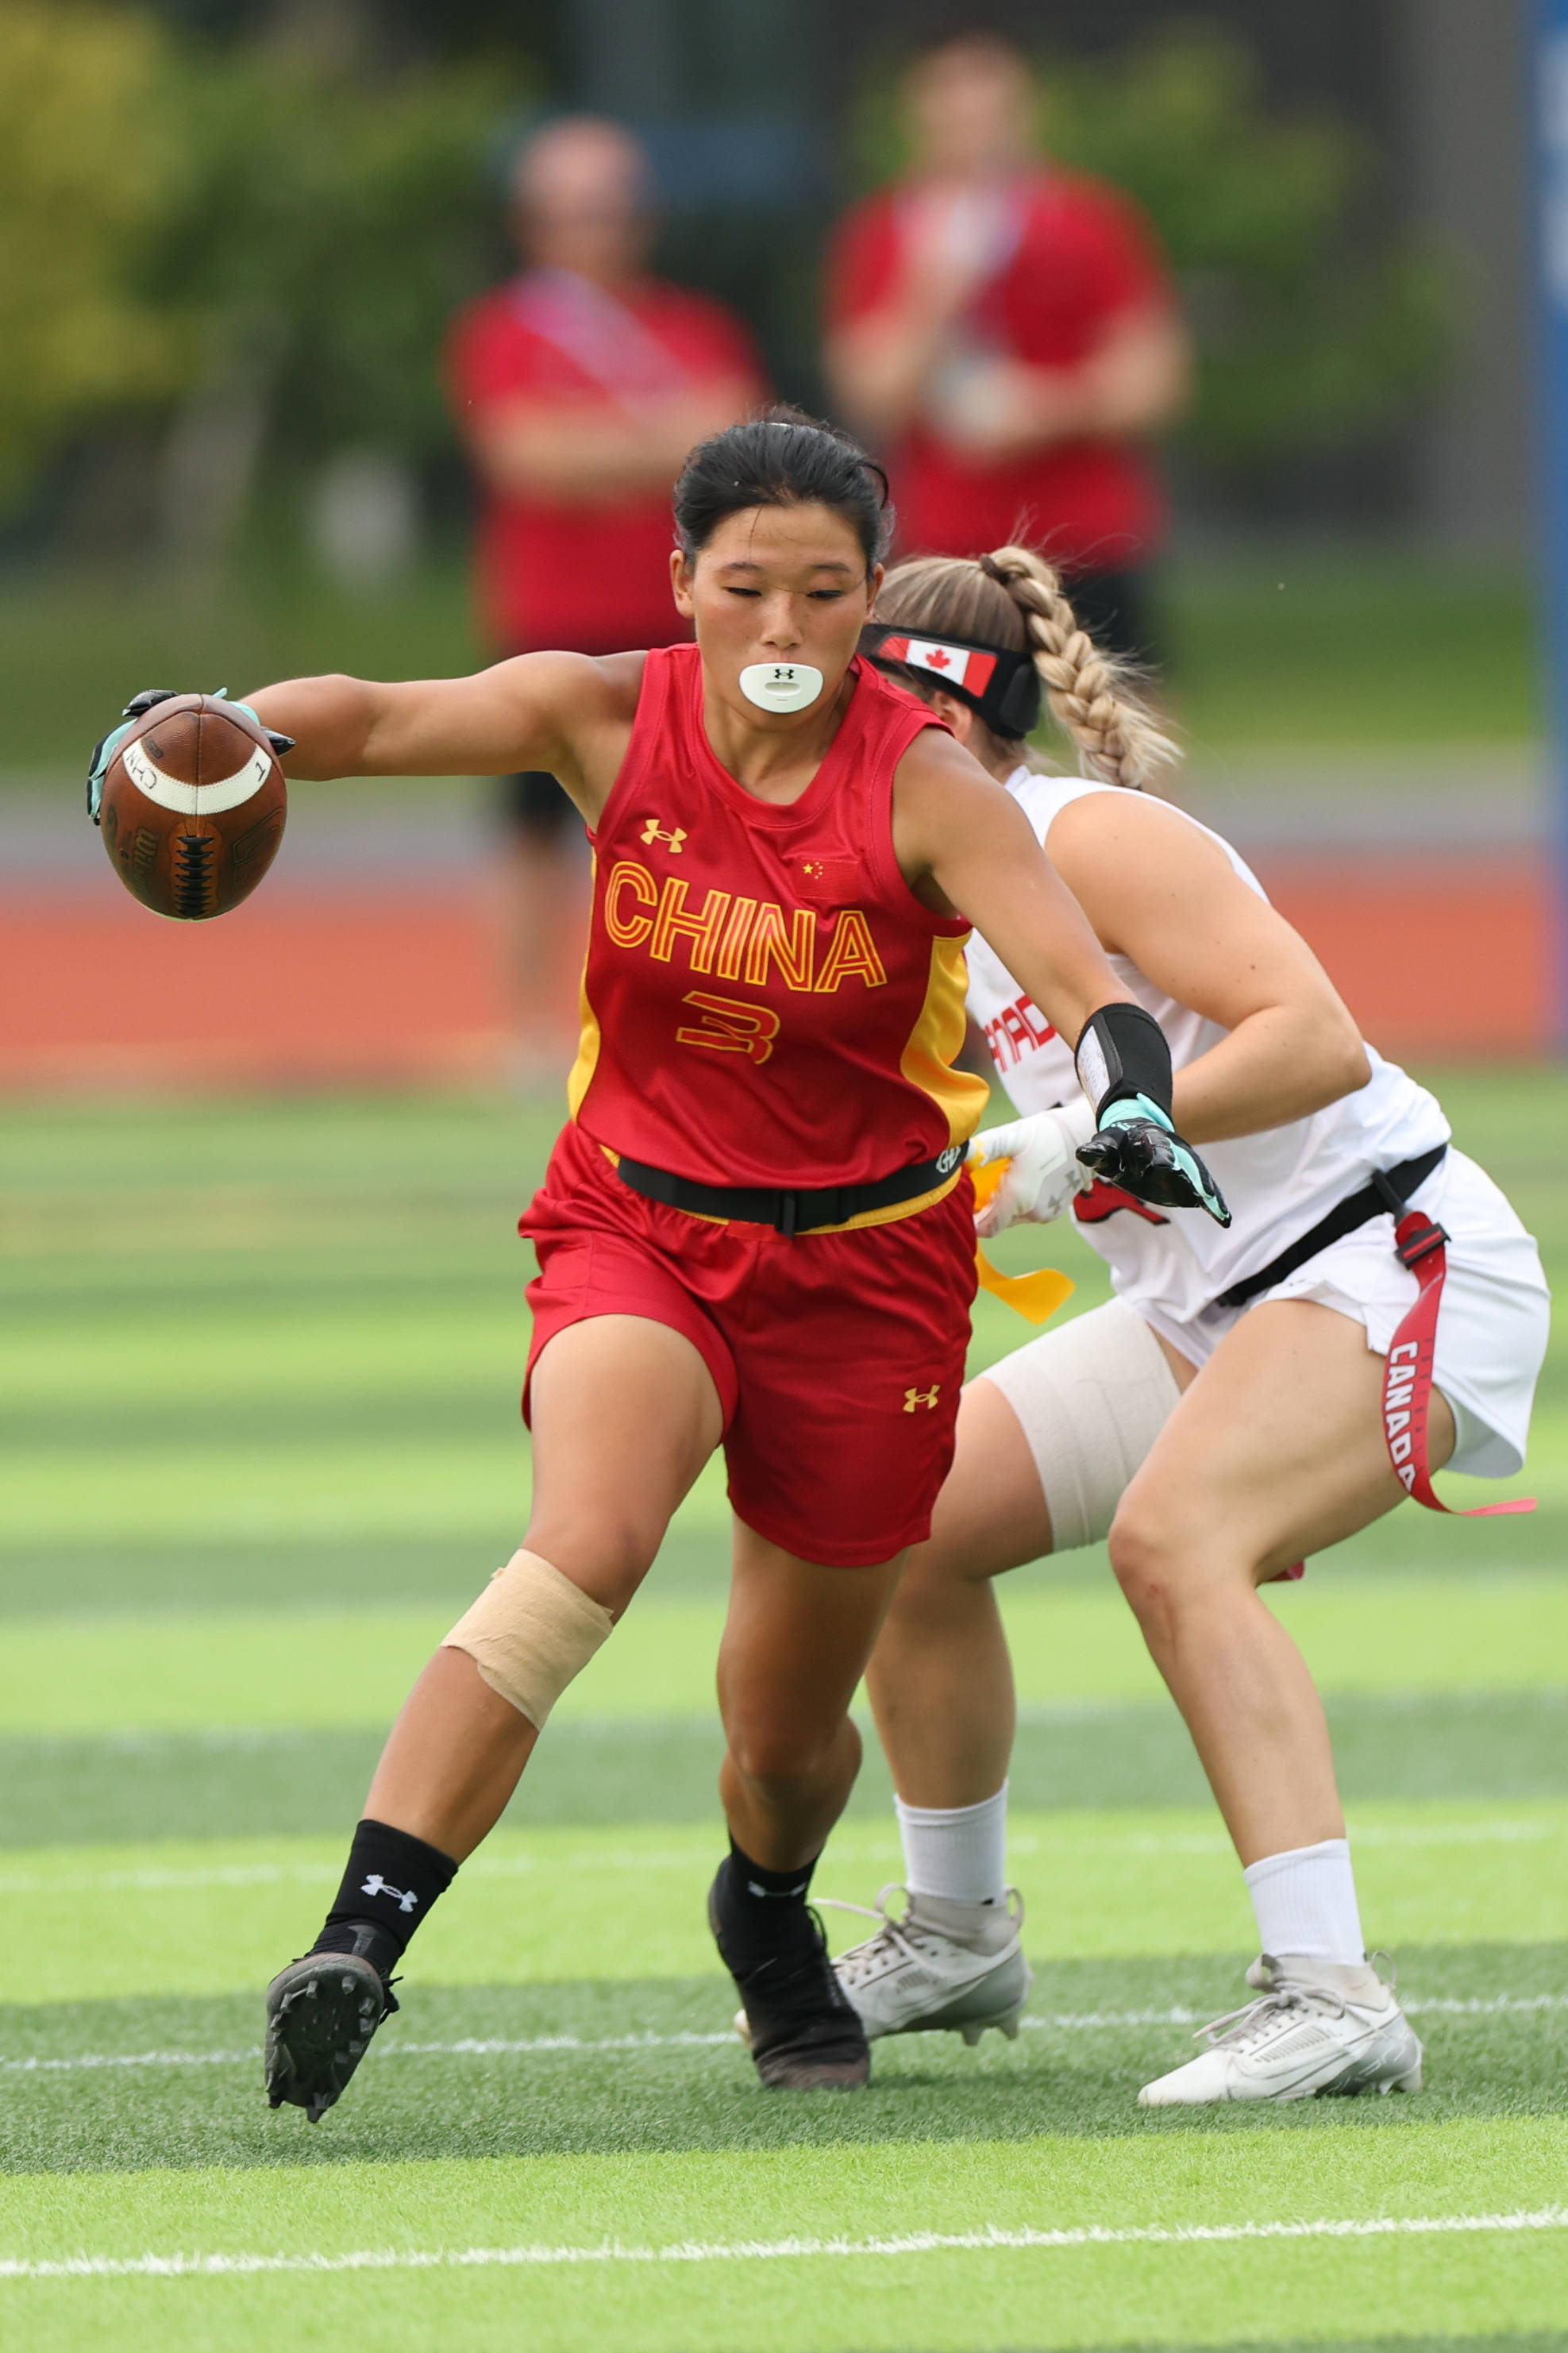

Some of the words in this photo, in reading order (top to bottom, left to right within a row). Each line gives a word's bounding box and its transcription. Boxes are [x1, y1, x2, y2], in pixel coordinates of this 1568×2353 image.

[605, 861, 888, 993] CHINA
[676, 990, 780, 1065] 3
[1385, 1340, 1420, 1493] CANADA
